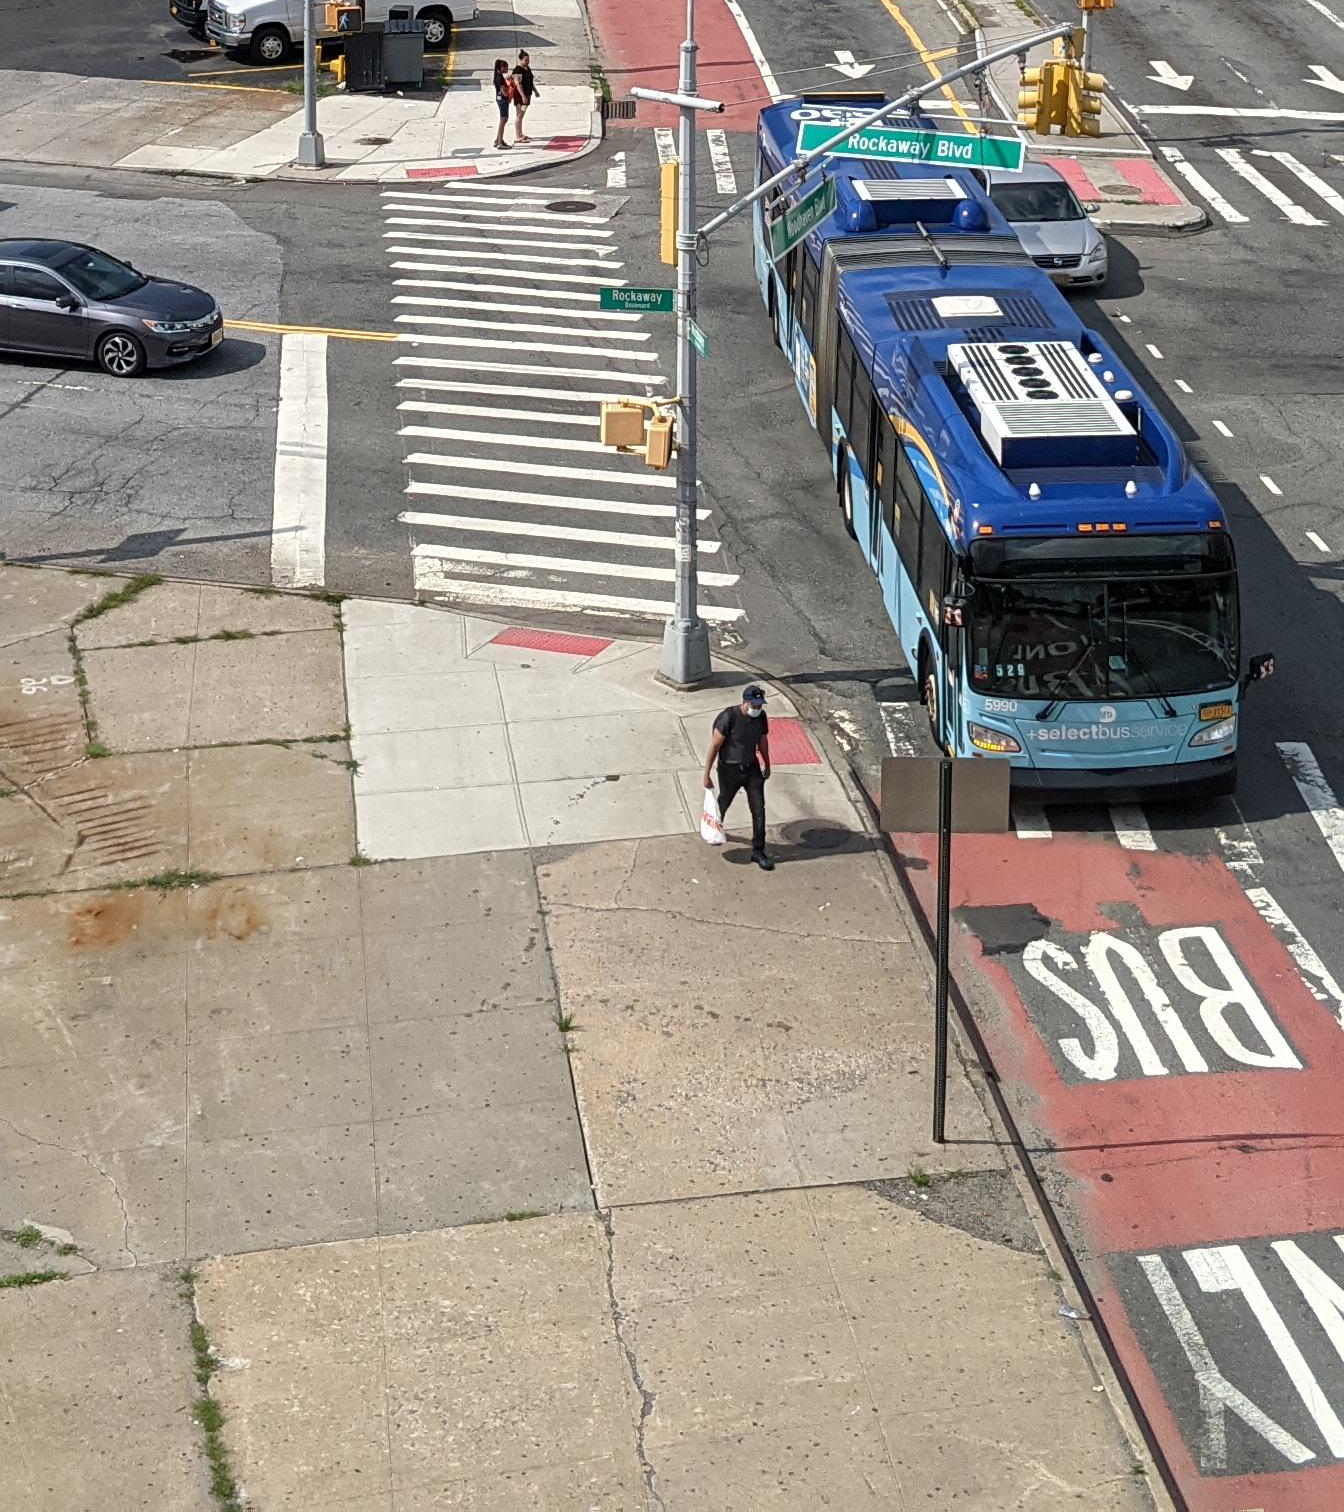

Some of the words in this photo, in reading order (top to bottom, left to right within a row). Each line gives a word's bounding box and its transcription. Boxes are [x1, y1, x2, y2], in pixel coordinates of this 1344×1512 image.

[848, 133, 930, 157] Rockaway
[937, 140, 973, 160] Blvd
[612, 290, 662, 304] Rockaway
[996, 664, 1024, 676] 529
[985, 698, 1018, 712] 5990
[1021, 926, 1306, 1081] BUS
